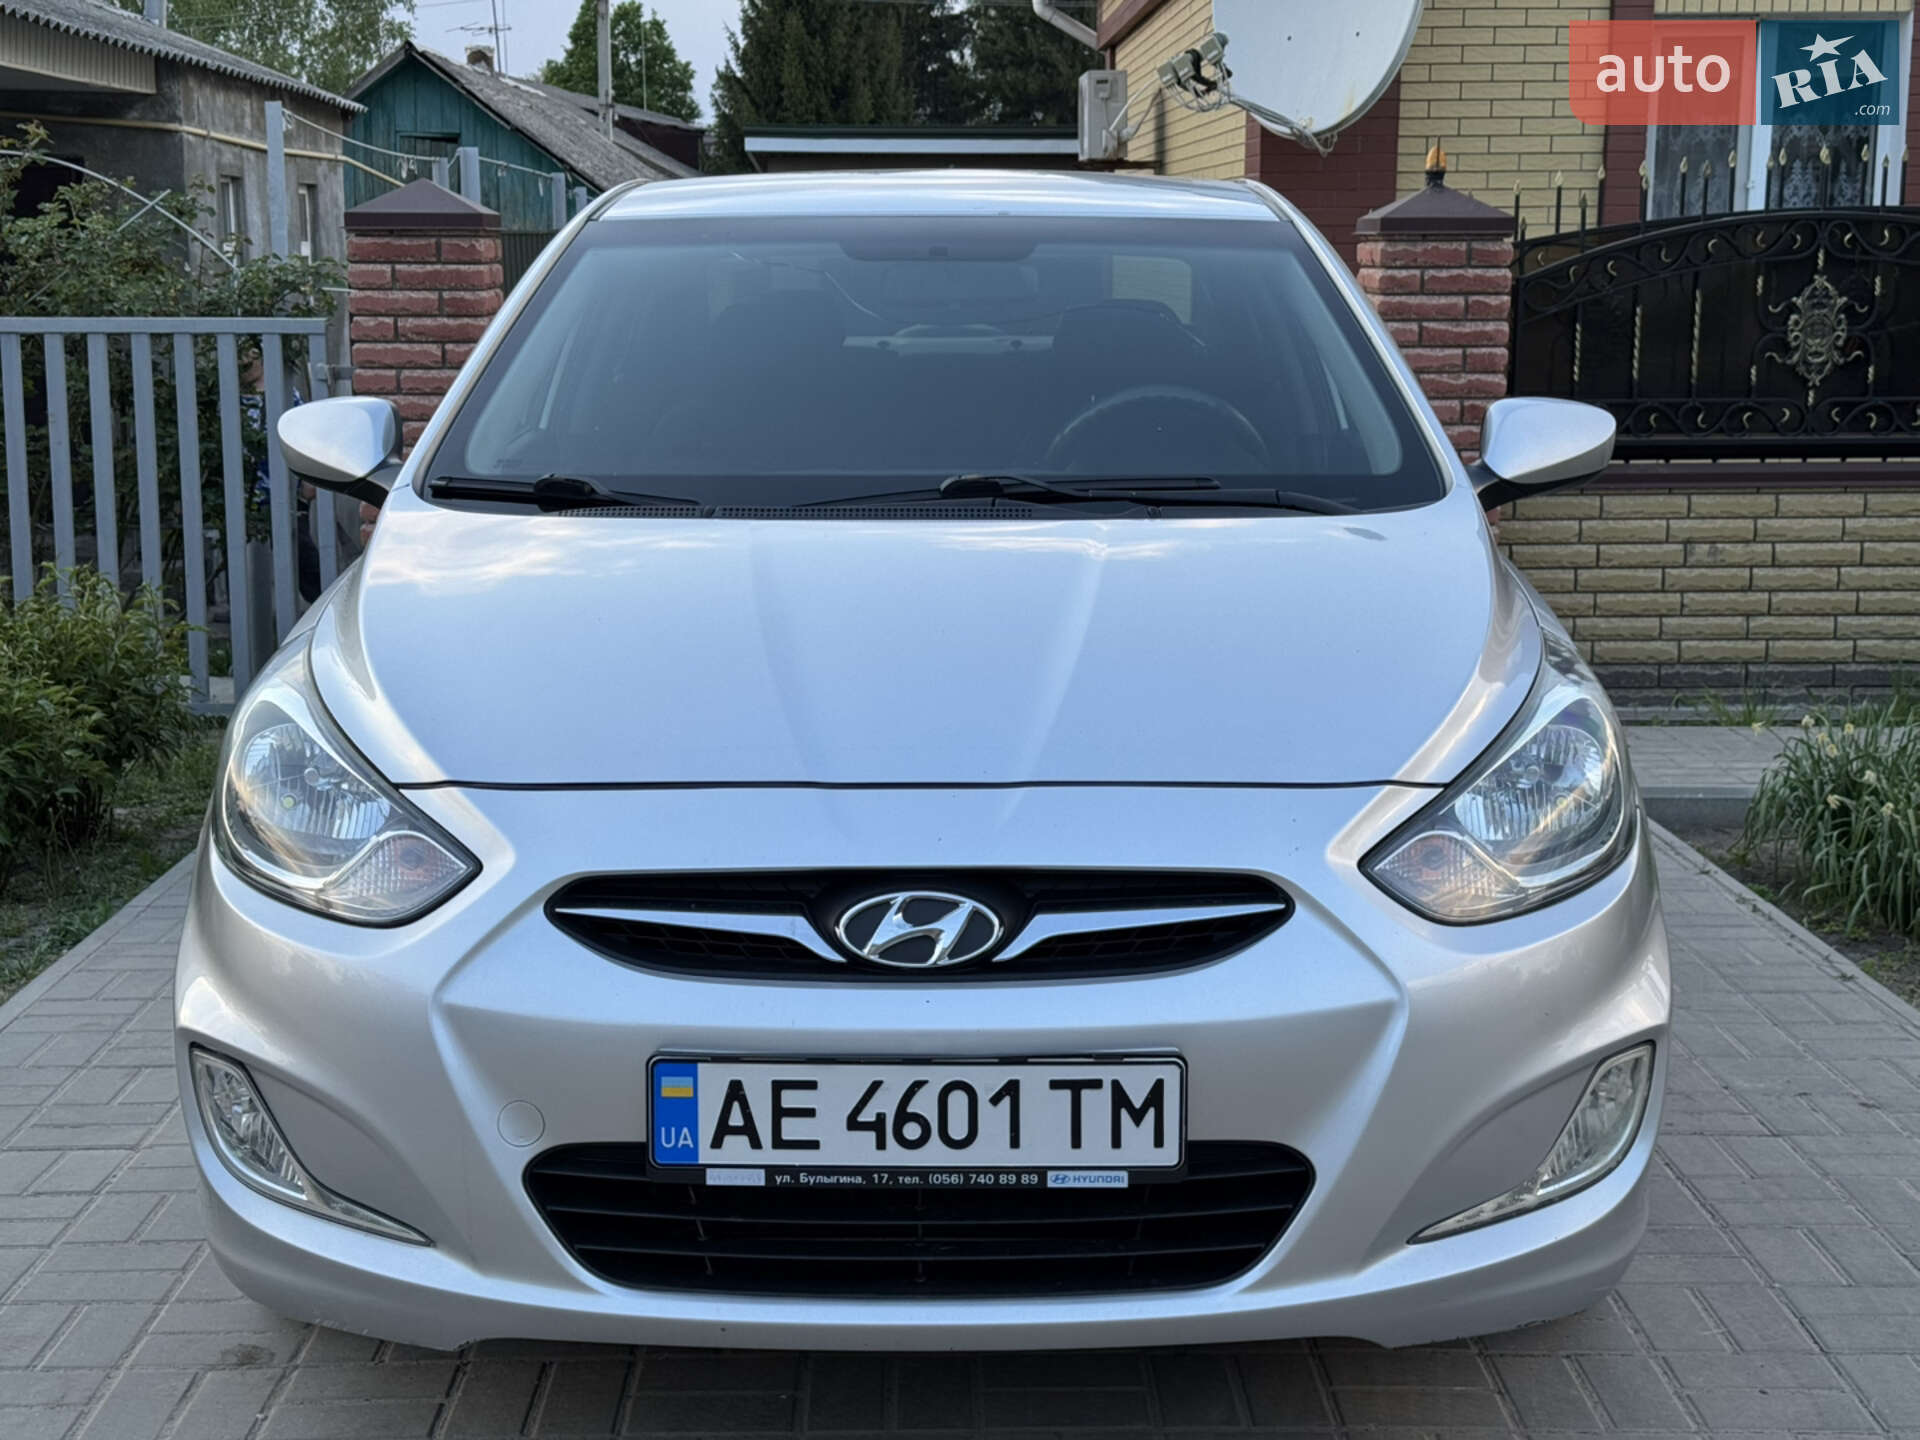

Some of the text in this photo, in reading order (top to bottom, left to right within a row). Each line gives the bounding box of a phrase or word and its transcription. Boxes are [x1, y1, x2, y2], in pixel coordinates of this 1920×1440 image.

[710, 1078, 1165, 1151] AE 4601 TM
[660, 1126, 694, 1149] UA
[775, 1174, 795, 1185] ул.
[800, 1172, 866, 1186] Булыгина,
[872, 1173, 893, 1185] 17,
[898, 1175, 924, 1185] тел.
[928, 1173, 964, 1186] (056)
[969, 1174, 995, 1185] 740
[999, 1174, 1017, 1185] 89
[1020, 1174, 1039, 1185] 89
[1072, 1175, 1125, 1184] HYUNDAI
